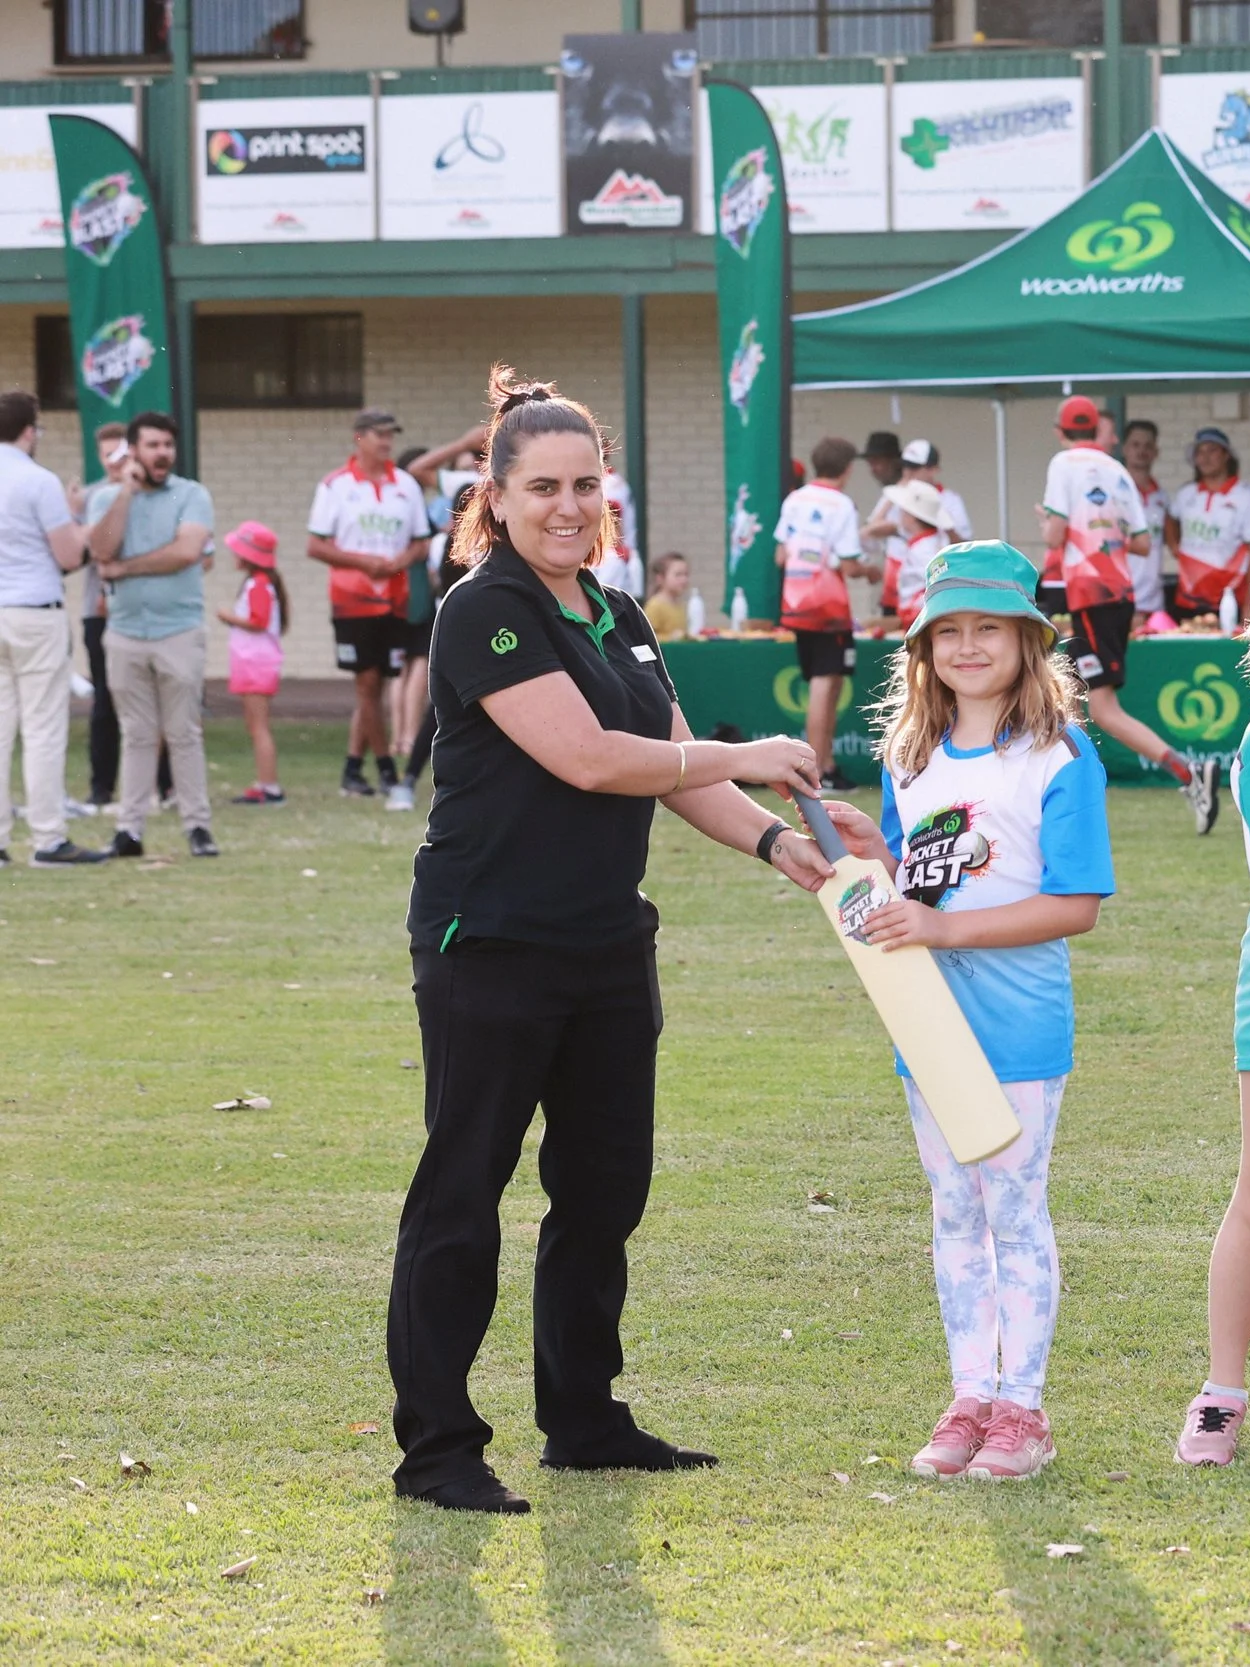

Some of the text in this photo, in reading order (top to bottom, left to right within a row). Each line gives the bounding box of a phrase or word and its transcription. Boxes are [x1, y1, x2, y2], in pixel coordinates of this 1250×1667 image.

[249, 129, 362, 162] print spot
[1021, 271, 1185, 296] woolworths
[903, 853, 972, 891] LAST
[842, 894, 870, 920] CRICKET
